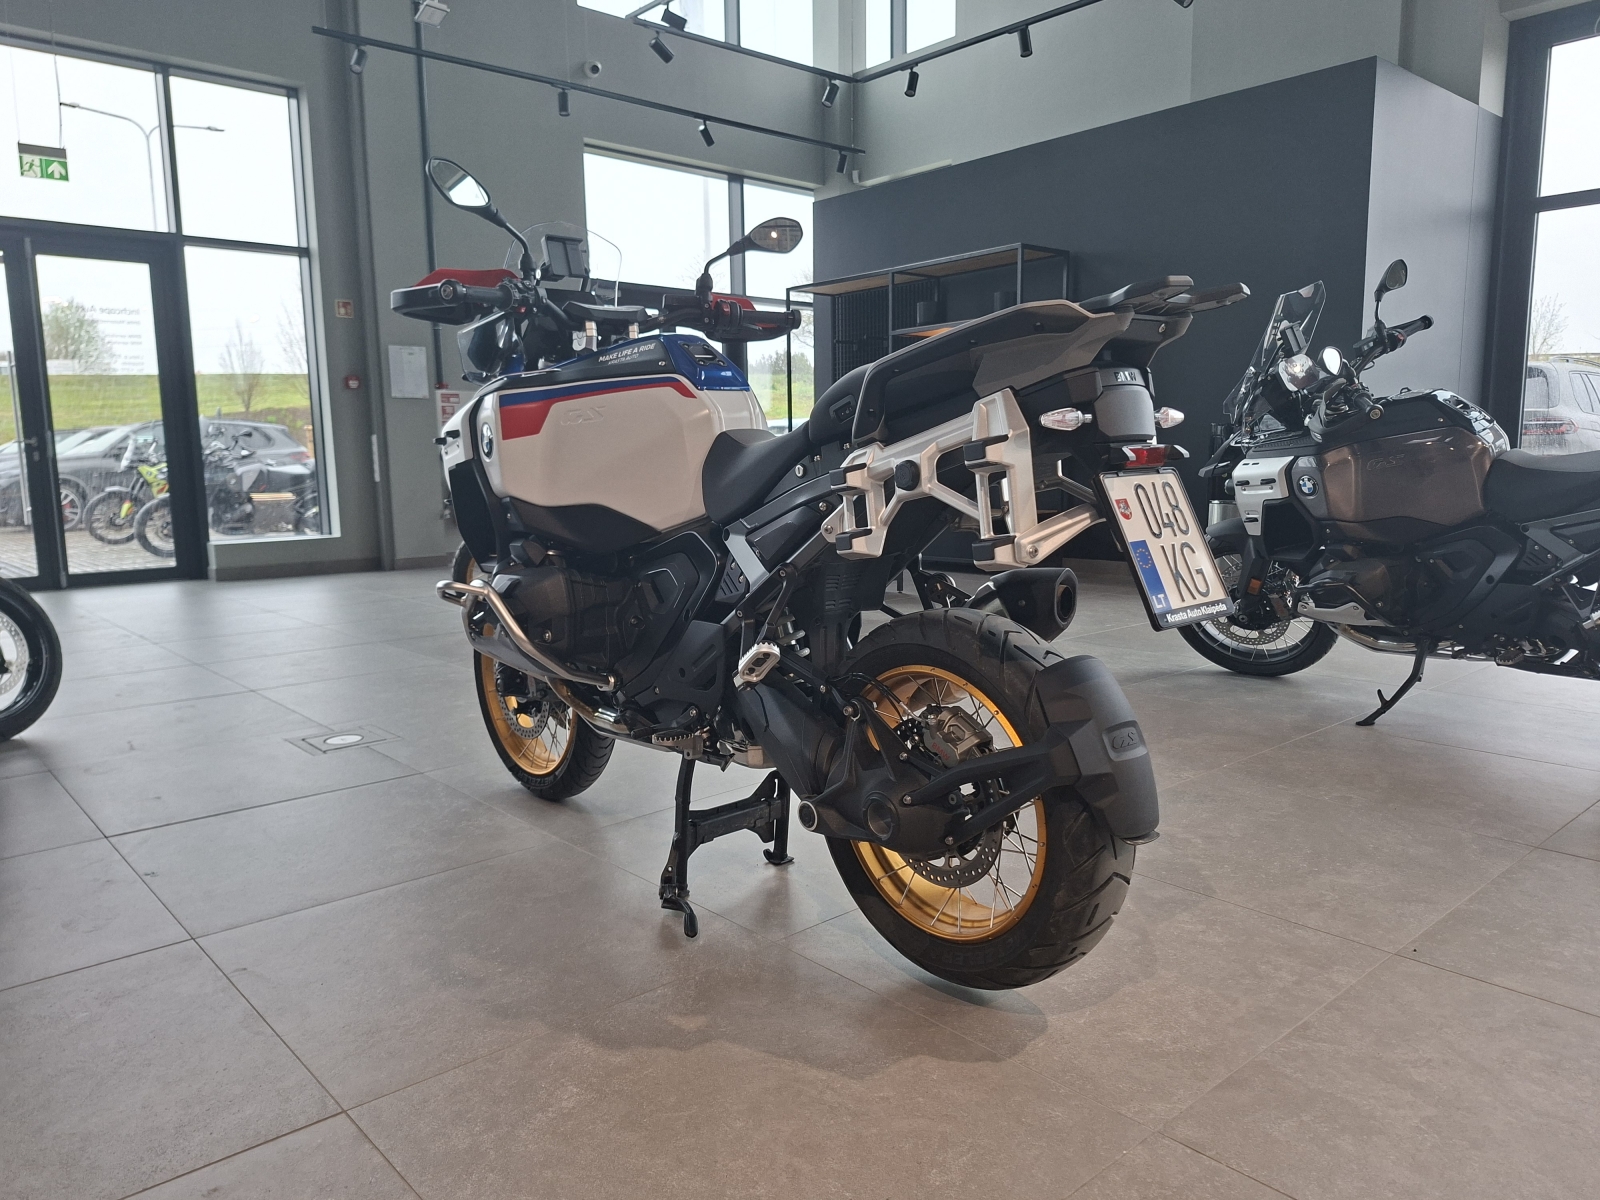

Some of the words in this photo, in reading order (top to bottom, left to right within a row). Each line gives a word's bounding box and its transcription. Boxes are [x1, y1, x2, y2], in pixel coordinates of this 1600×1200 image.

[598, 352, 618, 362] MAKE
[618, 348, 633, 358] LIFE
[639, 342, 656, 352] RIDE
[1113, 371, 1137, 382] BMW
[1133, 481, 1190, 539] 048
[1160, 541, 1211, 603] KG
[1151, 593, 1166, 609] LT
[1166, 611, 1188, 623] Krasta
[1187, 608, 1202, 618] Auto
[1200, 602, 1227, 615] Klaipėda
